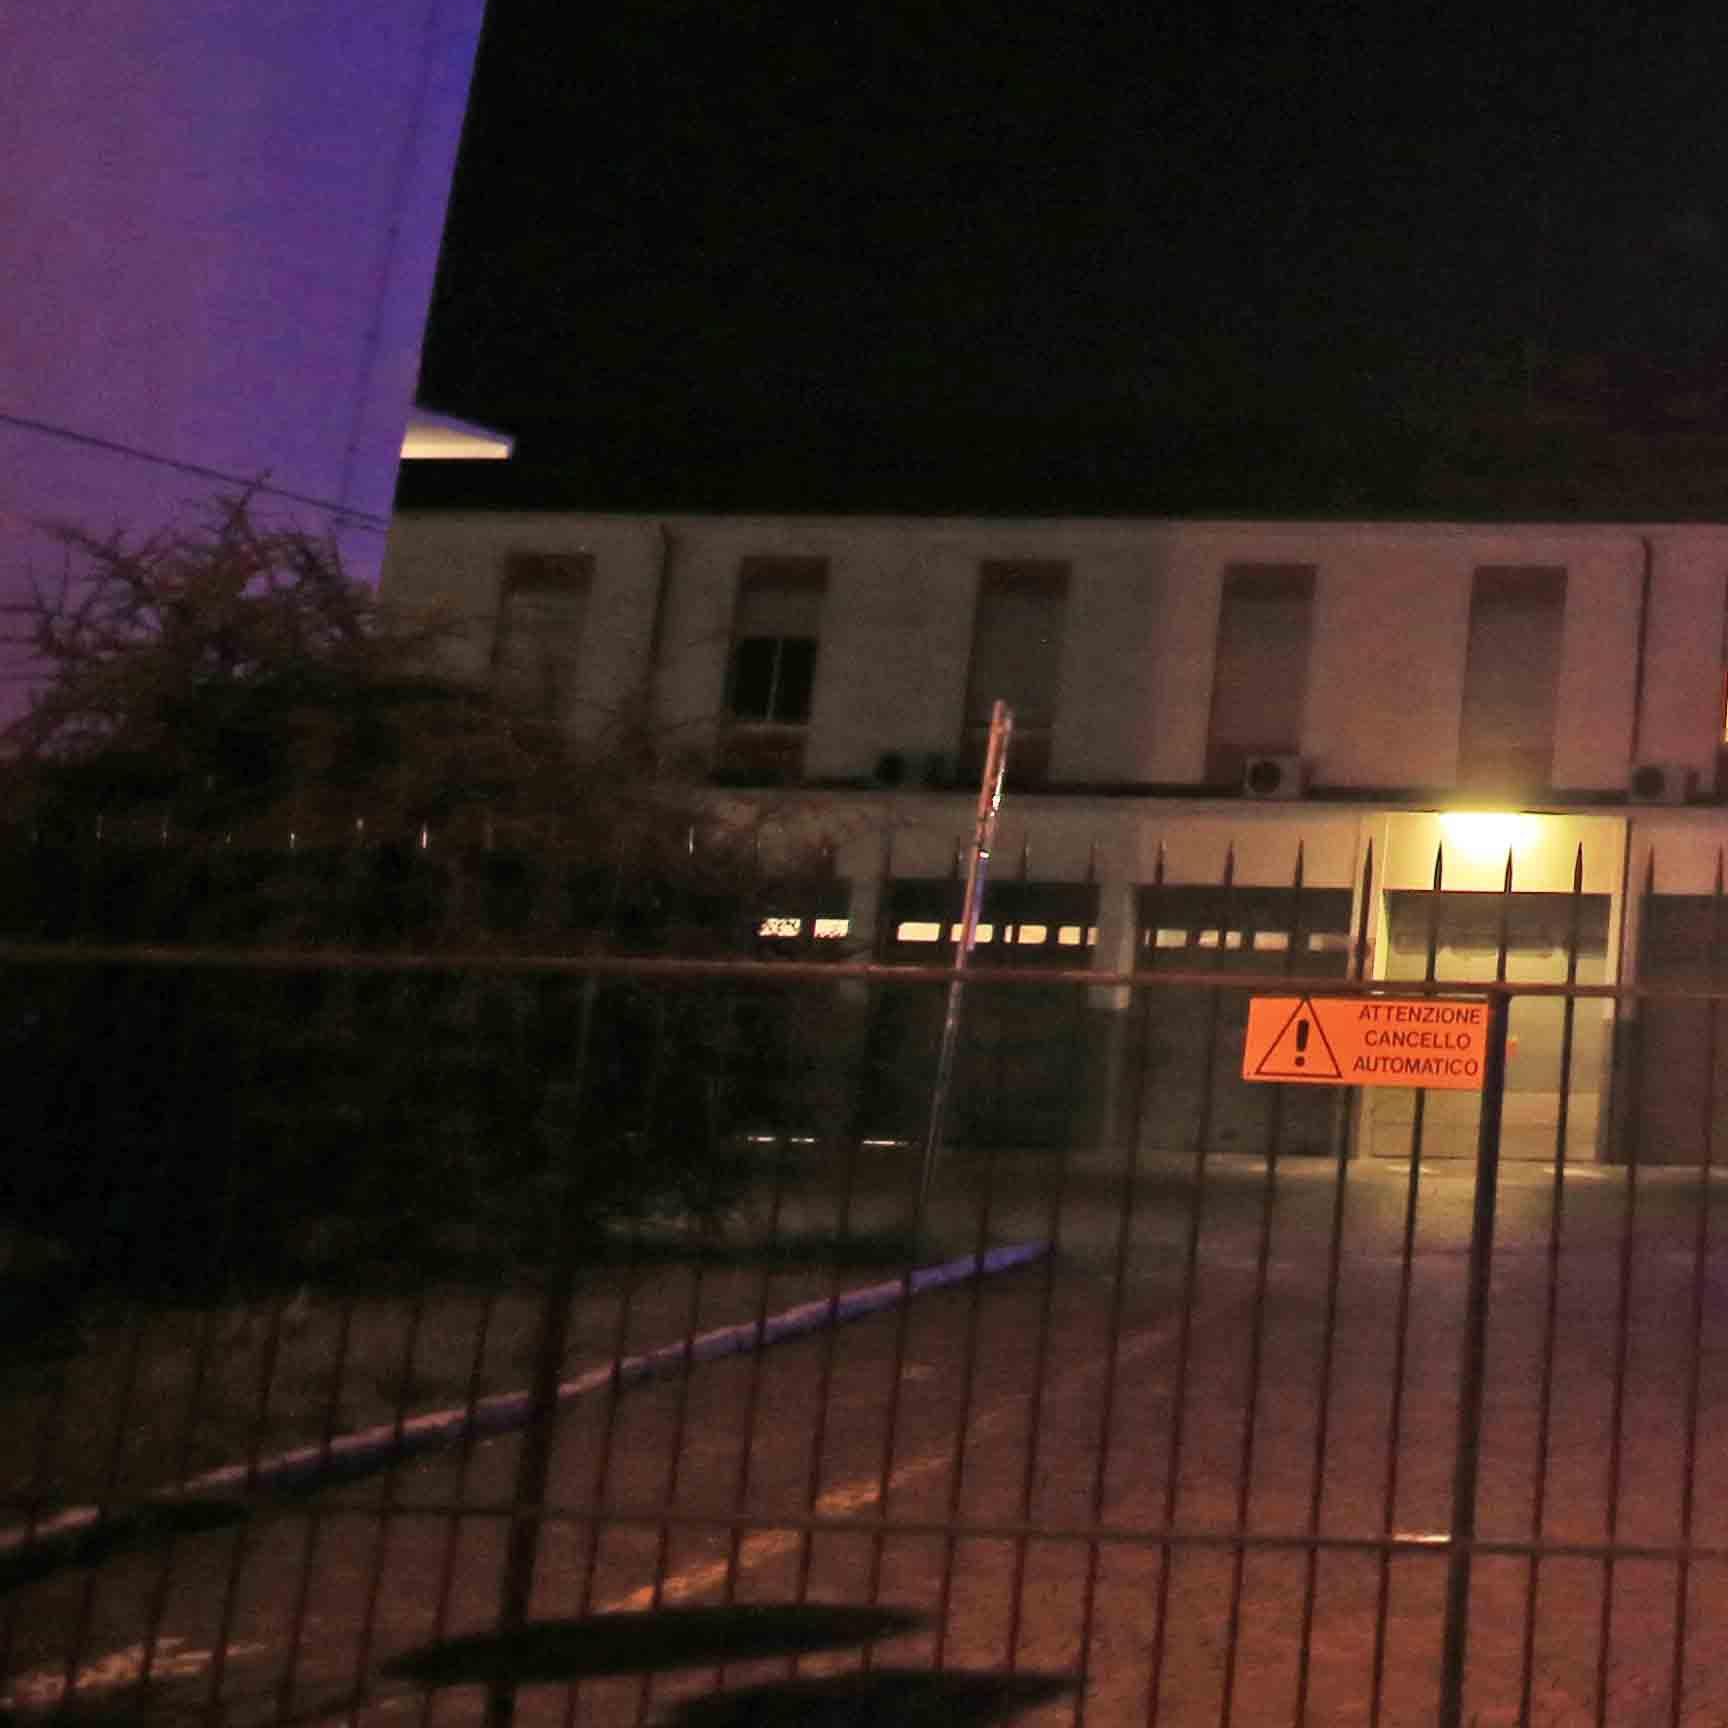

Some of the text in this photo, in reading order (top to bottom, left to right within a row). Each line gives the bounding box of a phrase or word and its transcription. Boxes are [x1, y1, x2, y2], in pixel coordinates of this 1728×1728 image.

[1359, 1004, 1481, 1025] ATTENZIONE
[1364, 1029, 1472, 1050] CANCELLO
[1352, 1055, 1479, 1077] AUTOMATICO
